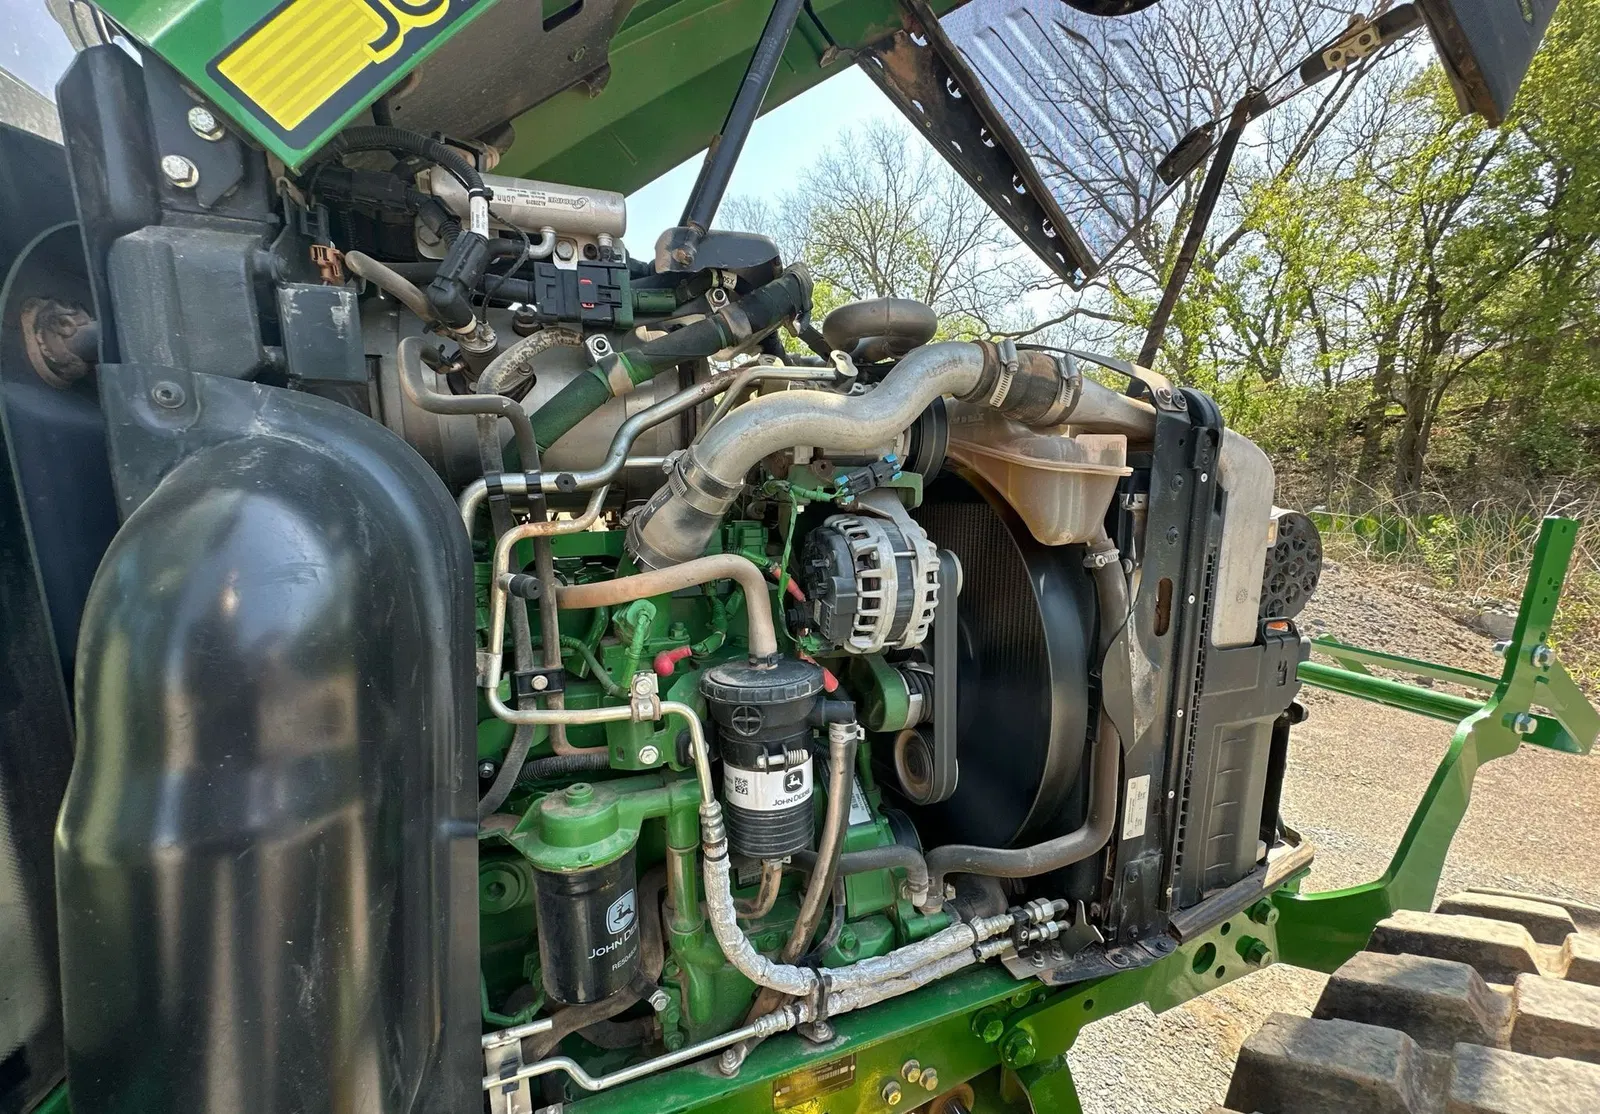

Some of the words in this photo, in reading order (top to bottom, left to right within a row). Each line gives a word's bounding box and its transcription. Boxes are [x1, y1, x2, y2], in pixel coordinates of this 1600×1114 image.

[772, 798, 793, 806] JOHN
[794, 788, 810, 801] DEERE
[588, 938, 622, 959] JOHN
